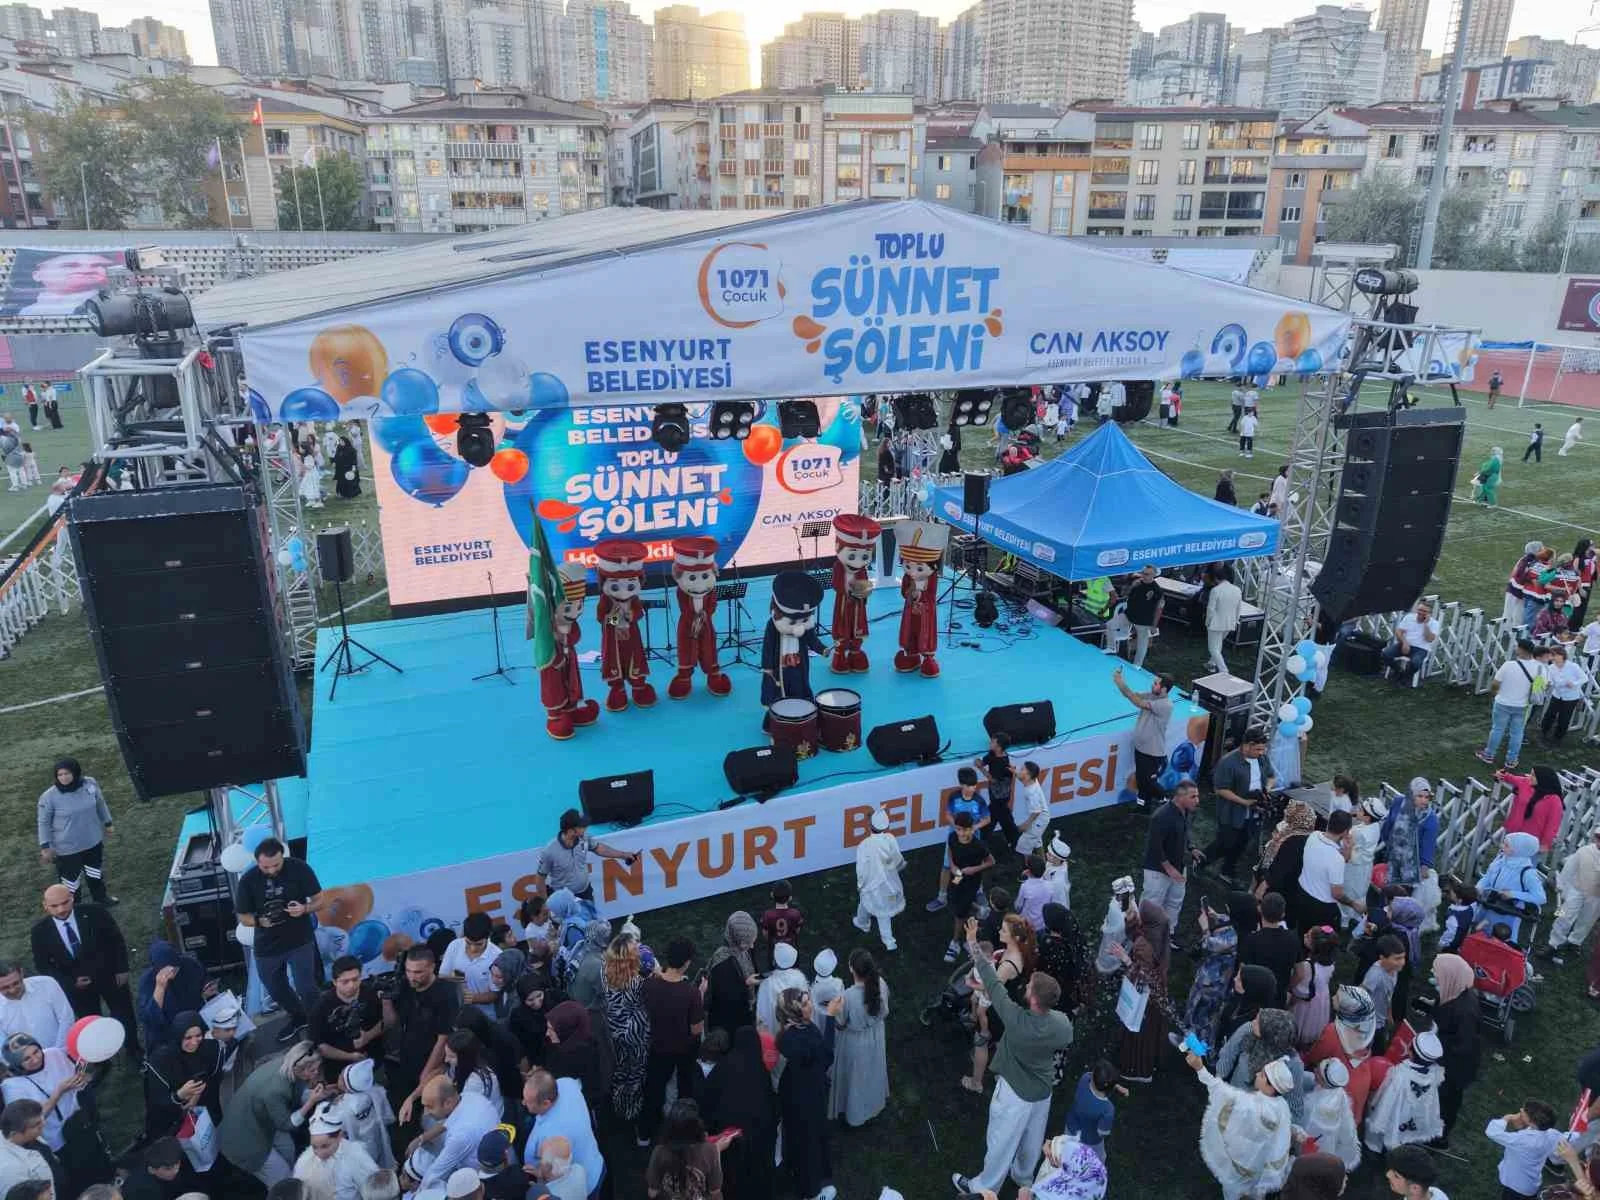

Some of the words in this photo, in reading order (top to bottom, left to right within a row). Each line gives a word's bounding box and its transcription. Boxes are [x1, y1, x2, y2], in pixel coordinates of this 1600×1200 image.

[875, 232, 945, 259] TOPLU
[716, 269, 769, 289] 1071
[810, 254, 1000, 318] SÜNNET
[722, 289, 767, 305] Çocuk
[584, 338, 732, 364] ESENYURT
[1030, 331, 1083, 354] CAN
[1091, 330, 1170, 352] AKSOY
[586, 362, 733, 393] BELEDİYESİ
[617, 449, 678, 467] TOPLU
[791, 457, 832, 471] 1071
[565, 464, 728, 504] SÜNNET
[762, 512, 792, 525] CAN
[414, 540, 492, 555] ESENYURT
[415, 549, 493, 566] BELEDİYESİ
[1132, 544, 1182, 561] ESENYURT
[1184, 537, 1236, 553] BELEDİYESİ
[775, 918, 788, 937] 9
